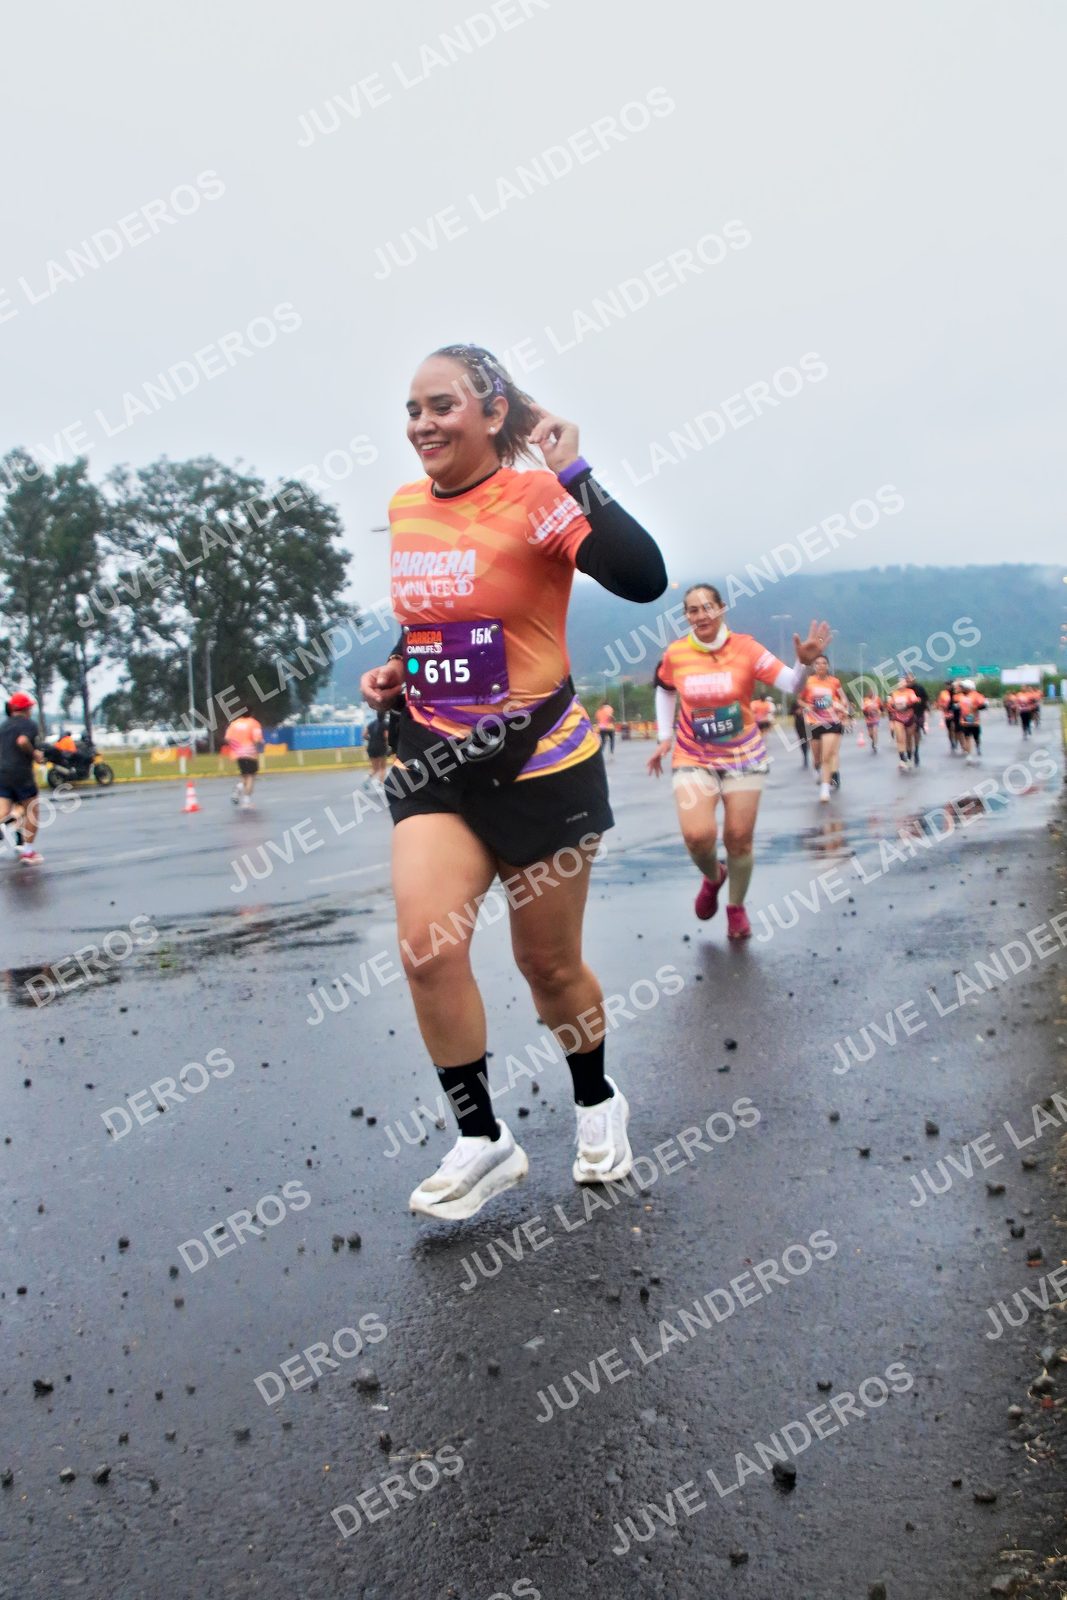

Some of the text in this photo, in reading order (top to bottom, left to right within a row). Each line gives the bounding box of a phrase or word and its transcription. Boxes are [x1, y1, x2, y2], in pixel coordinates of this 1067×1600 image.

[391, 550, 477, 577] CARRERA
[407, 631, 442, 645] CARRERA
[470, 627, 493, 645] 15K
[424, 658, 471, 684] 615
[702, 719, 734, 734] 1155
